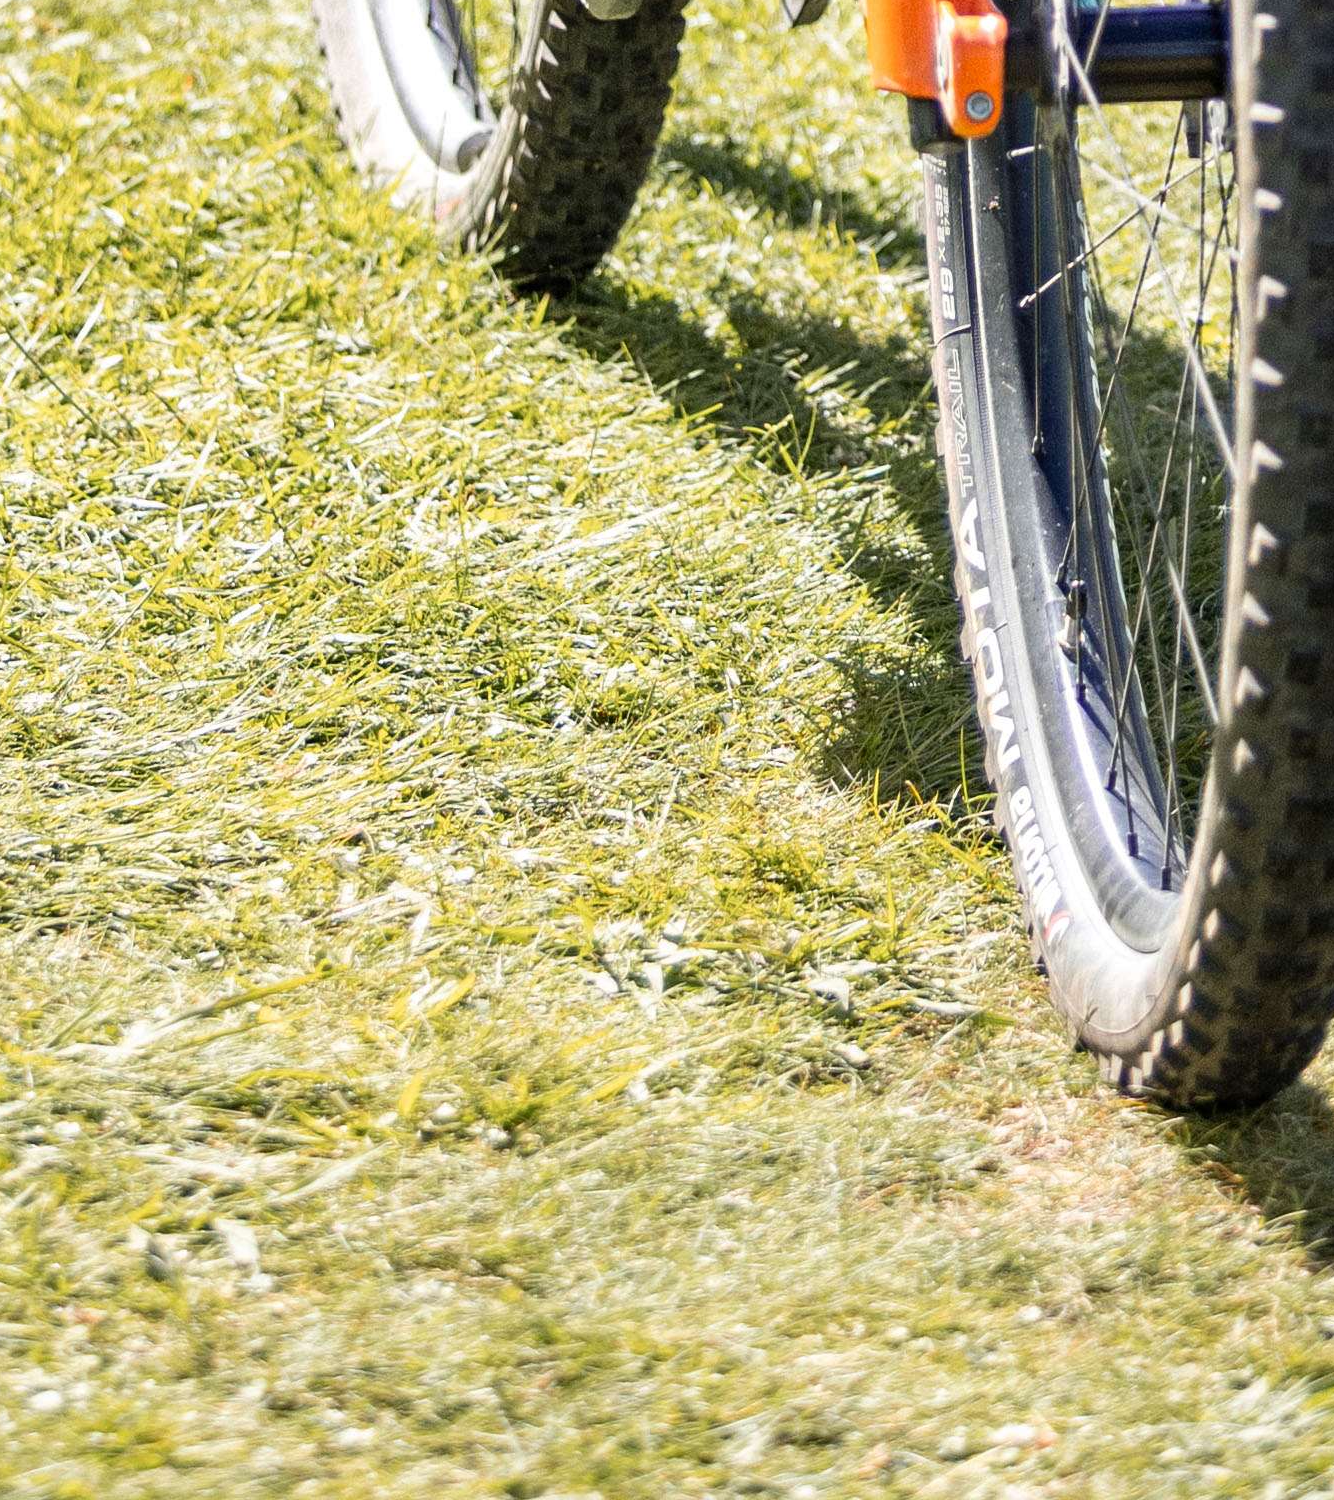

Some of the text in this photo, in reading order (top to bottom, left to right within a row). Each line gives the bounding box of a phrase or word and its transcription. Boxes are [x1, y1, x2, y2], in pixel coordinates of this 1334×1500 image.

[939, 265, 957, 322] 29
[943, 347, 974, 498] TRAIL
[956, 497, 1019, 769] MOTA
